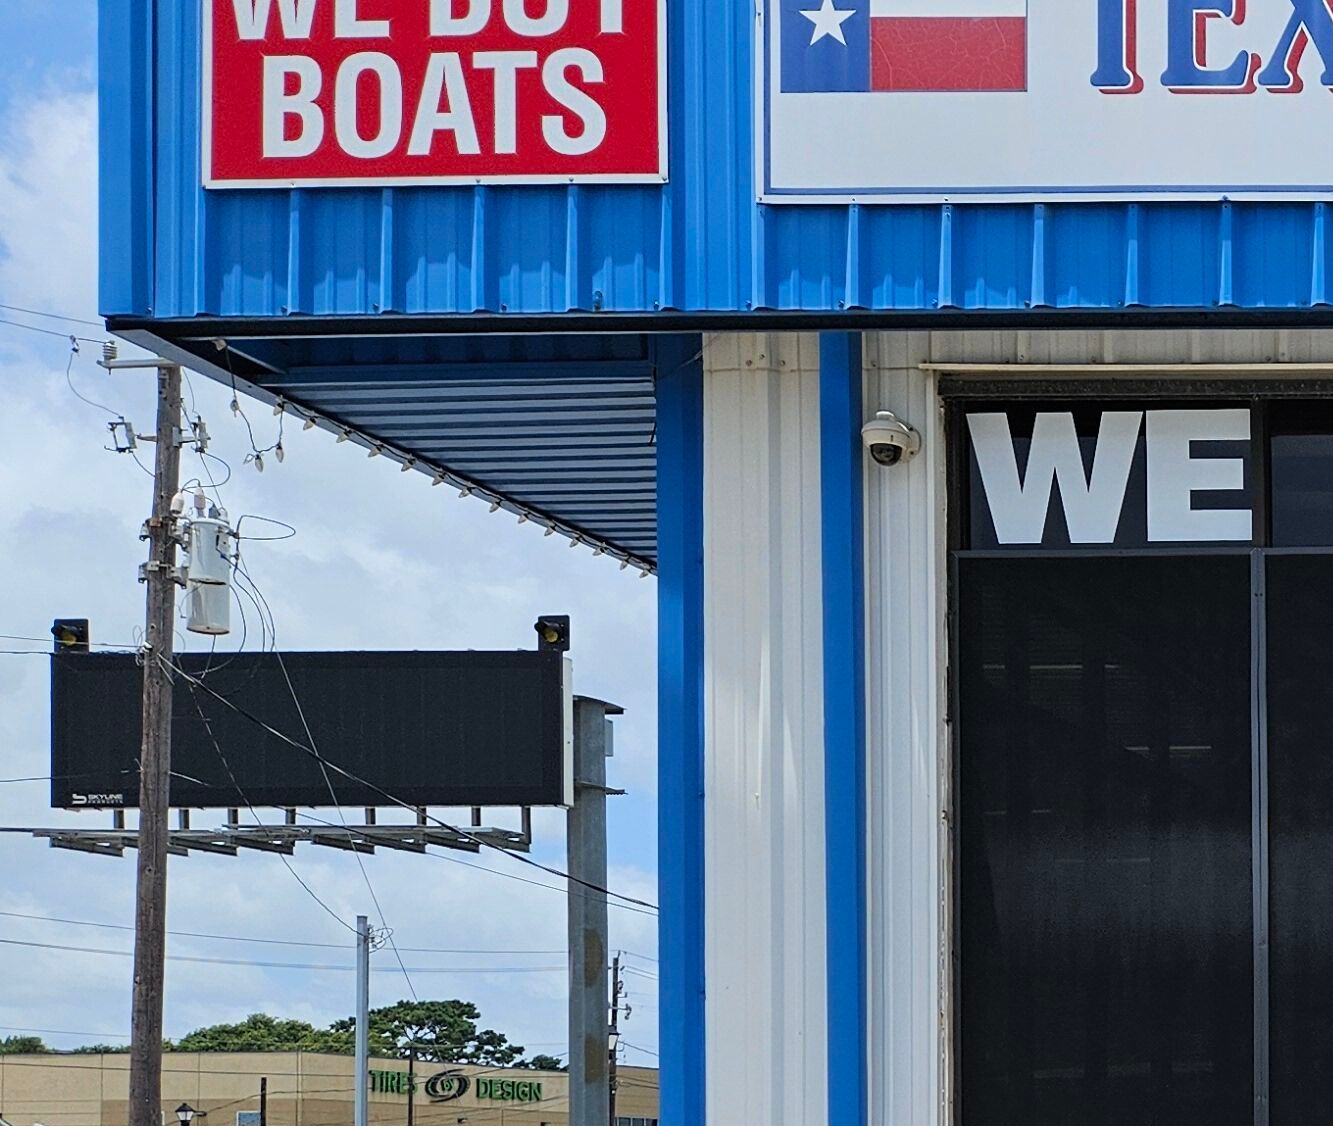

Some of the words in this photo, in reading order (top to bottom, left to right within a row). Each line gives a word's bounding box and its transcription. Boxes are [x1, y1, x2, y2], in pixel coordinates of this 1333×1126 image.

[262, 47, 607, 158] BOATS
[966, 408, 1253, 545] WE
[369, 1070, 418, 1095] TIRES
[476, 1078, 543, 1101] DESIGN
